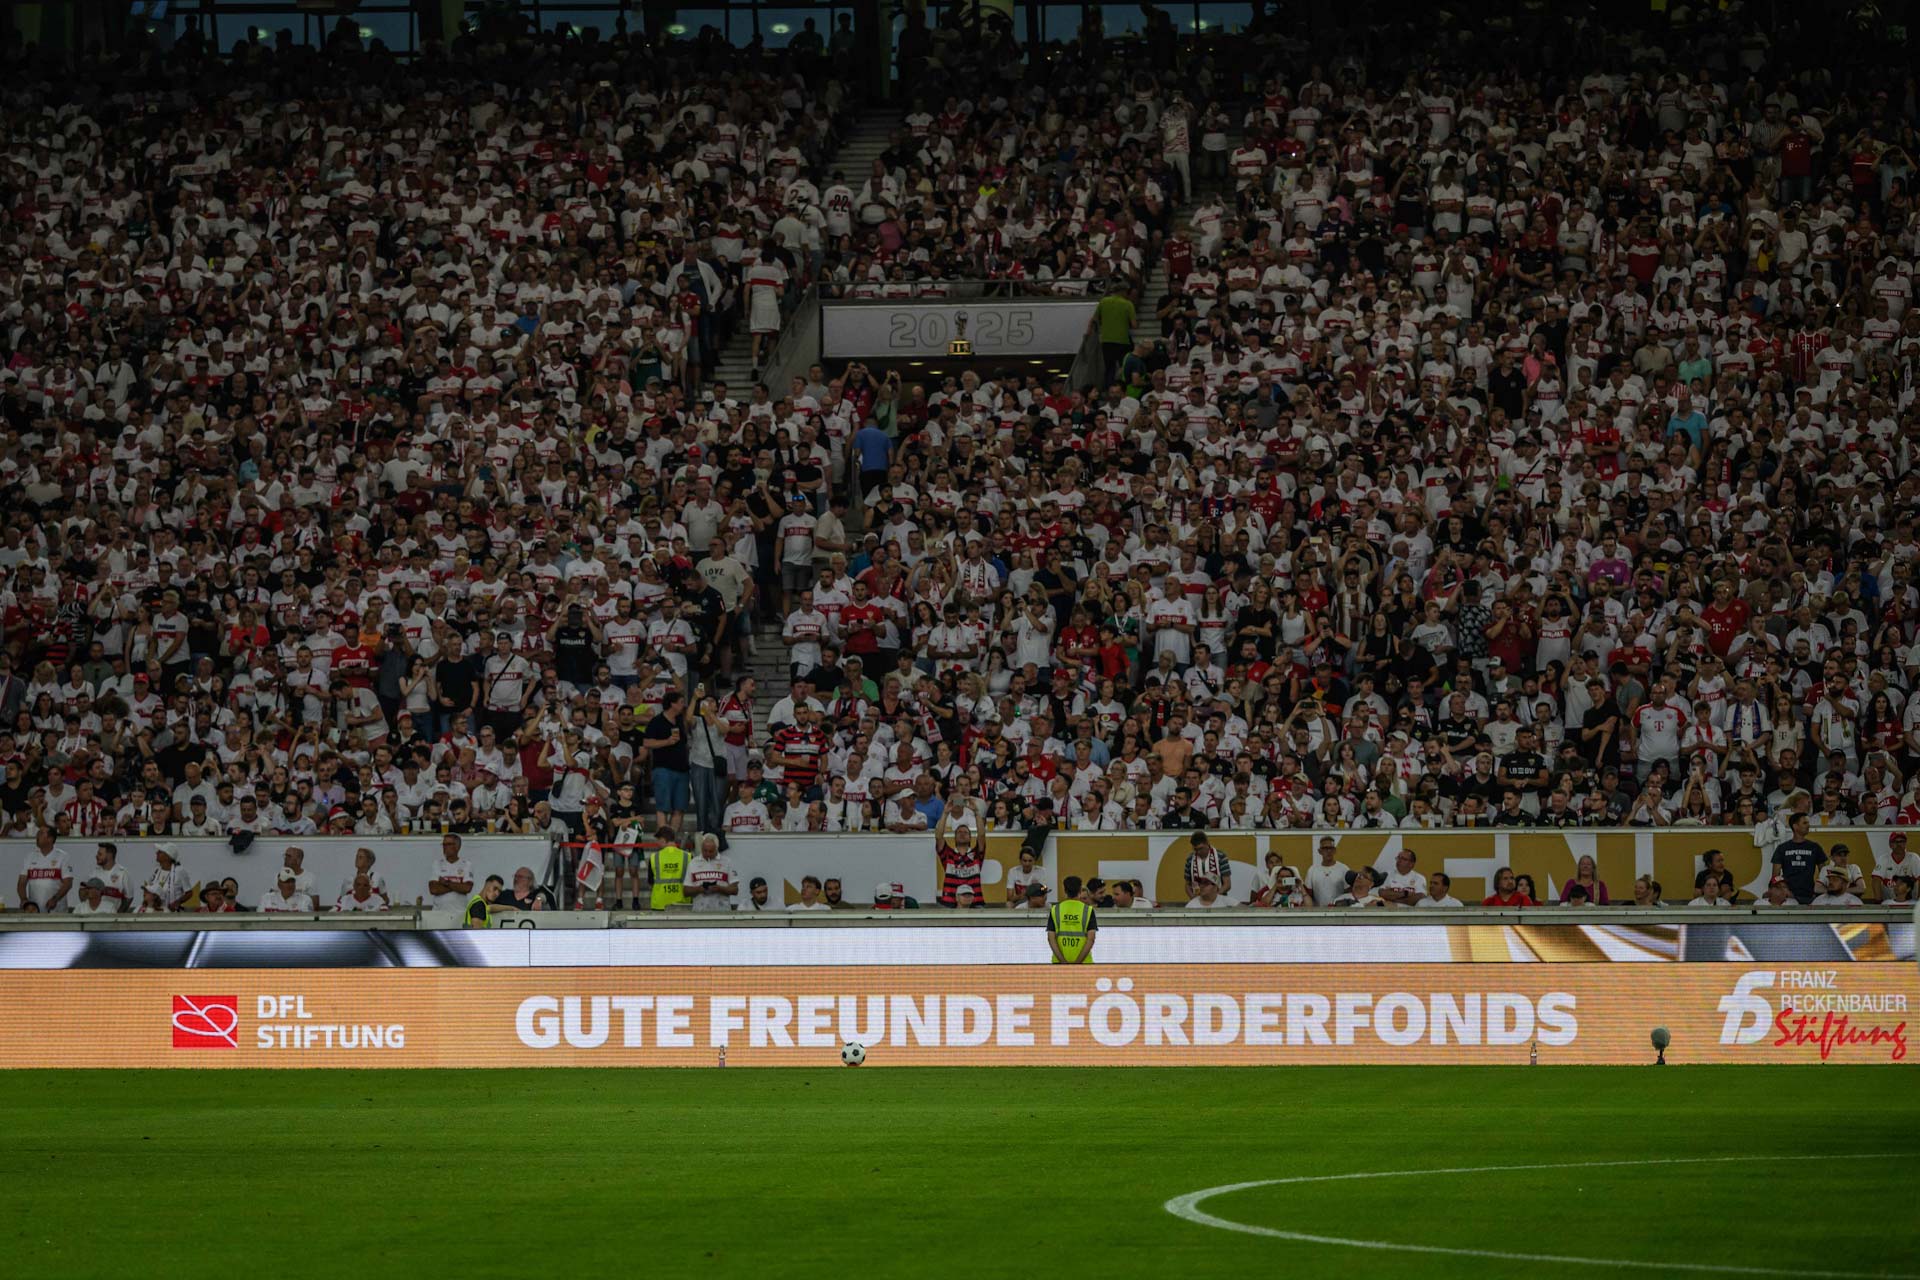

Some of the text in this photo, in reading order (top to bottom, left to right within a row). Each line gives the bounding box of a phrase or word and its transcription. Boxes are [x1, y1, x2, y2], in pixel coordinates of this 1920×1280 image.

[832, 193, 849, 212] 22
[695, 872, 725, 881] WINAMAX
[1780, 970, 1838, 989] FRANZ
[257, 996, 313, 1019] DFL
[516, 976, 1579, 1048] GUTE FREUNDE FÖRDERFONDS
[1780, 994, 1907, 1013] BECKENBAUER
[257, 1025, 405, 1049] STIFTUNG
[1774, 1007, 1908, 1061] Stiftung
